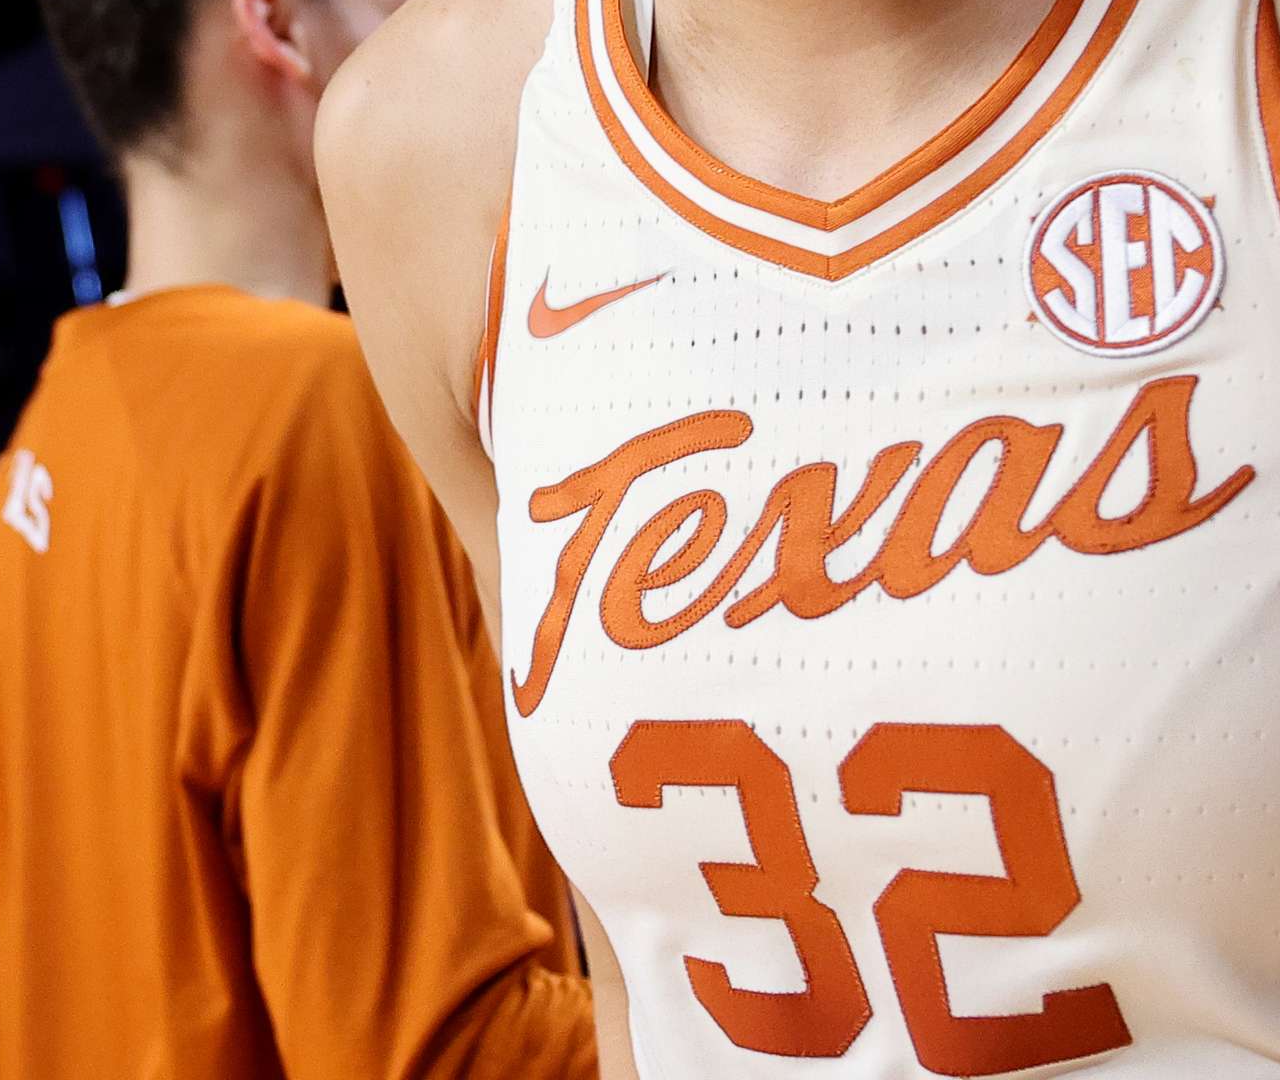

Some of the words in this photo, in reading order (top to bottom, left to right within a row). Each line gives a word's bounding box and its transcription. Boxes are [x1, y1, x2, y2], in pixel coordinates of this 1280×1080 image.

[1039, 182, 1206, 344] SEC
[510, 375, 1256, 718] Texas
[608, 719, 1133, 1077] 32
